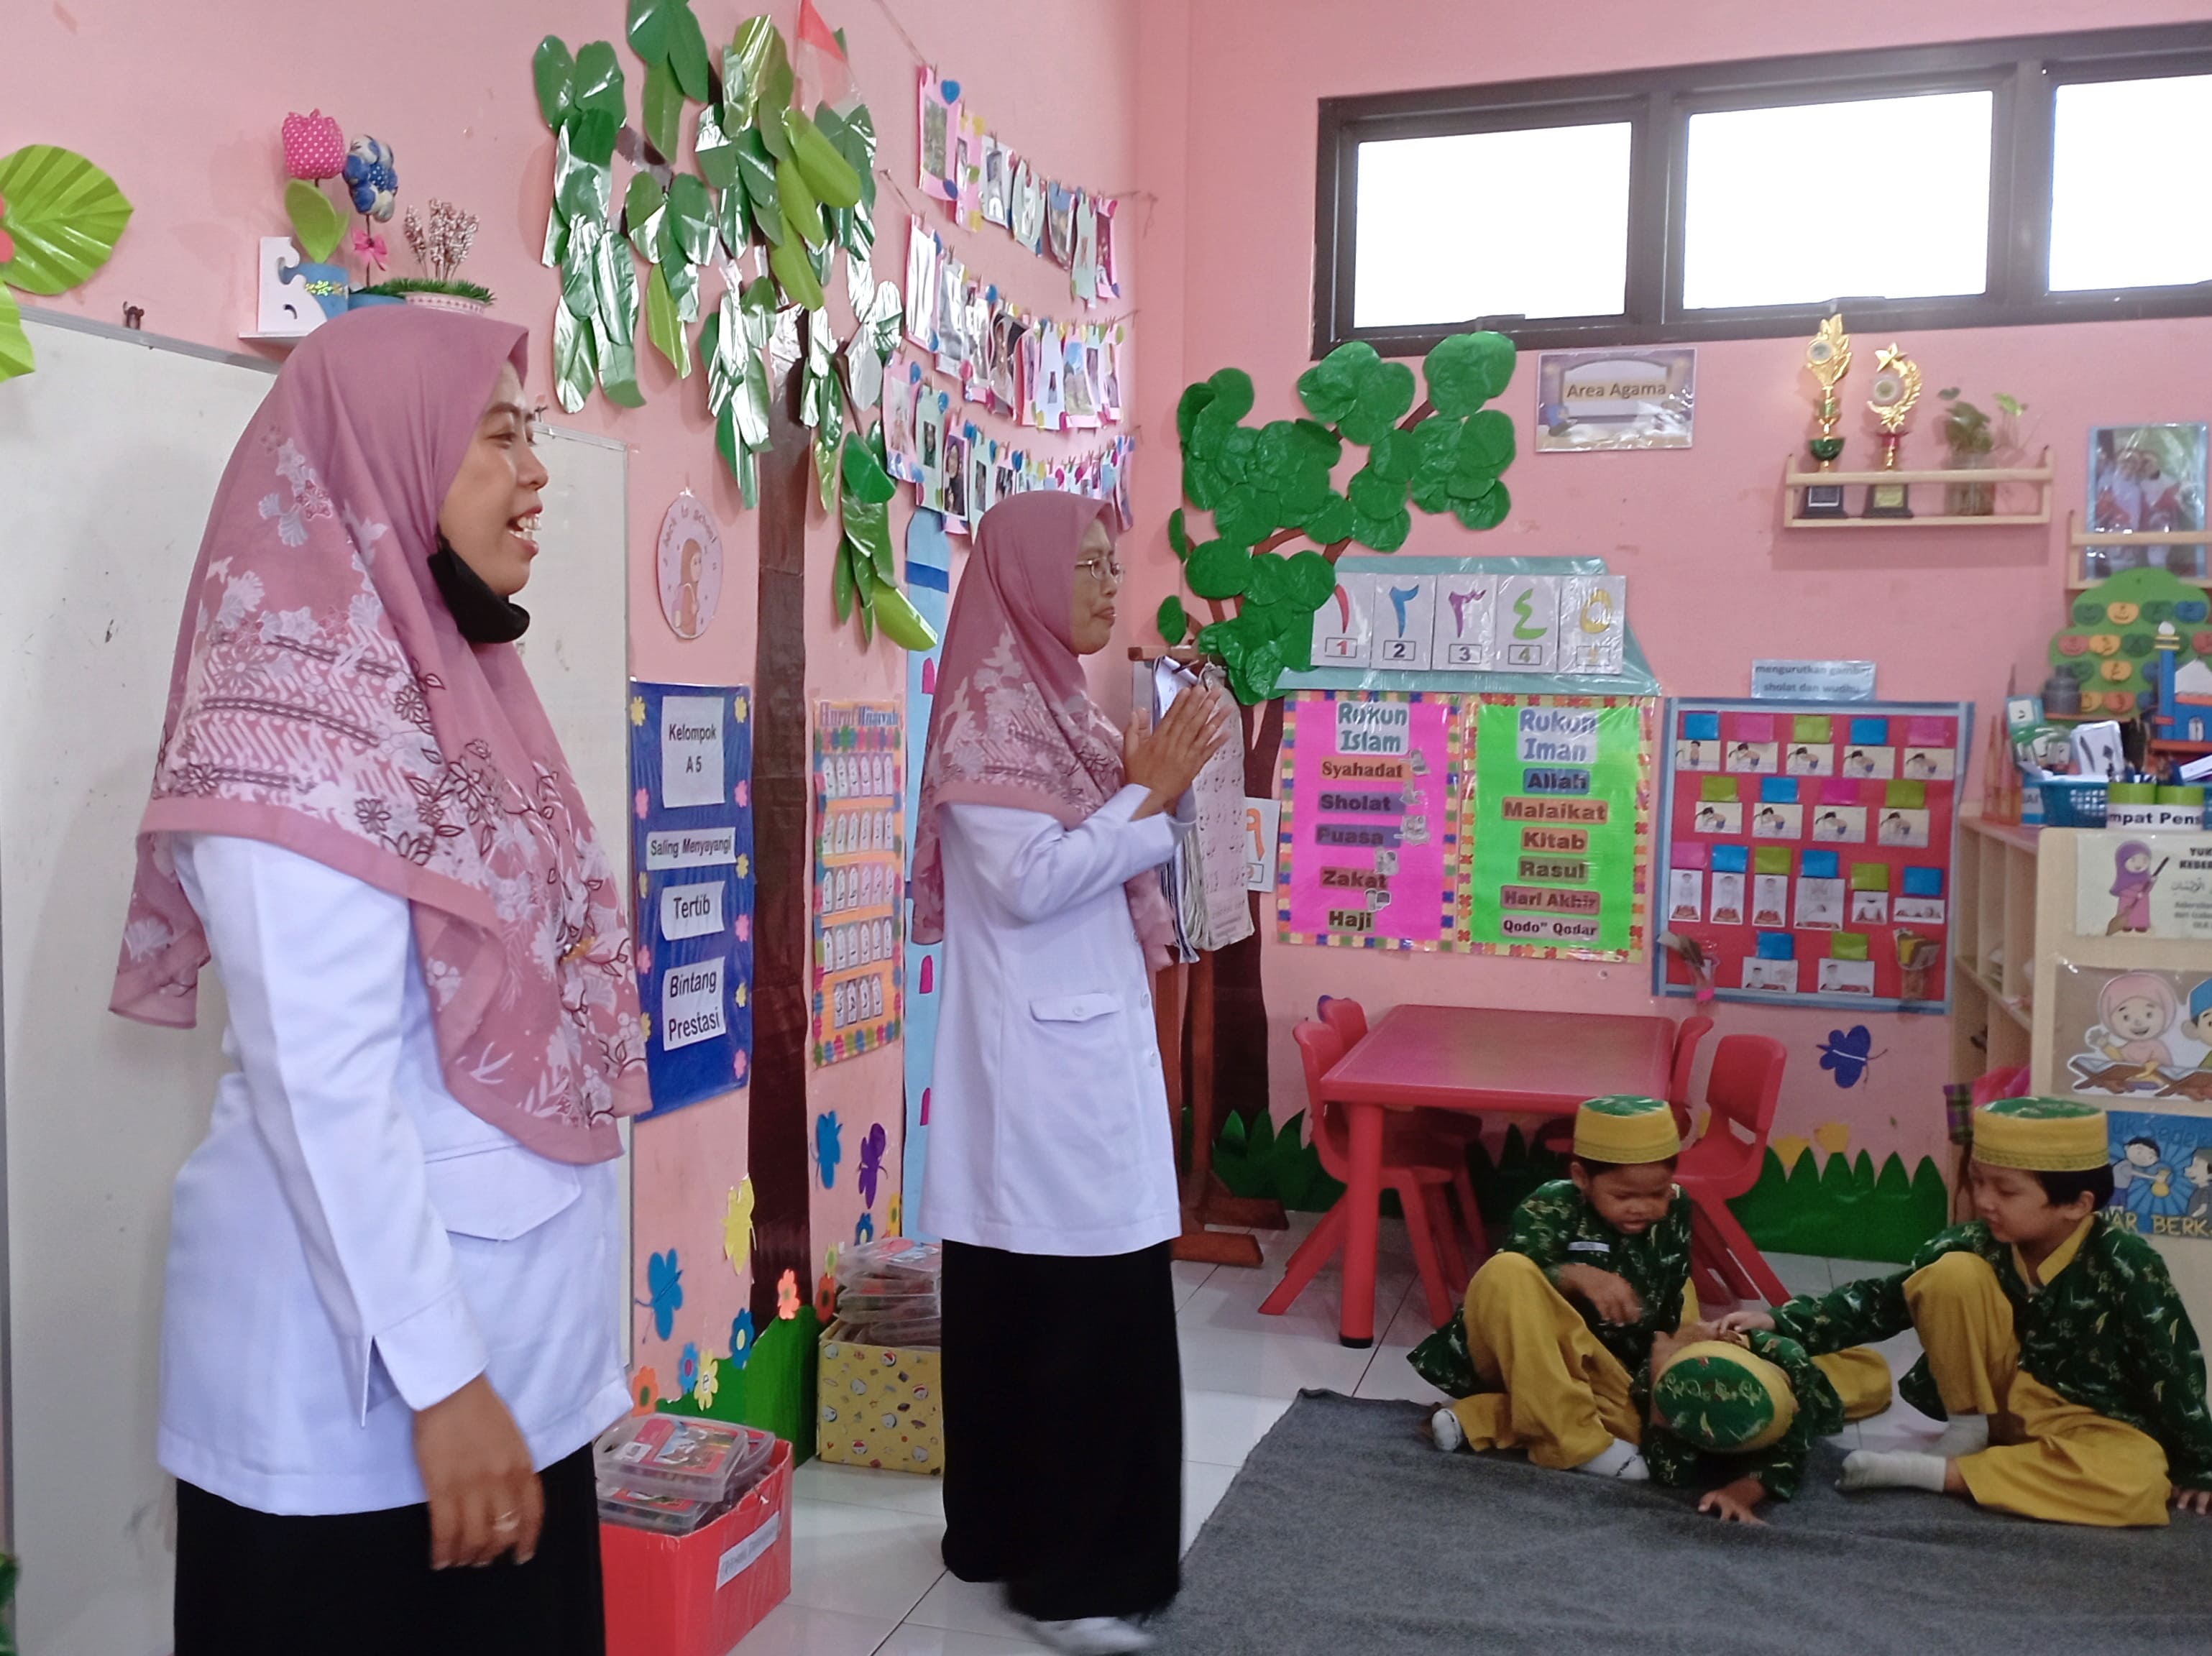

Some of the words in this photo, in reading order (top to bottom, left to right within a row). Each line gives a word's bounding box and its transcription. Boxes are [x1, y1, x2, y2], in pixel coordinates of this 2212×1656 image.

[1567, 383, 1605, 397] Area
[1610, 382, 1666, 399] Agama
[1336, 640, 1347, 656] 1
[1393, 643, 1405, 658] 2
[1459, 647, 1471, 661] 3
[1518, 647, 1530, 663] 4
[1756, 665, 1827, 675] mengurutkan
[1763, 682, 1796, 691] sholat
[1799, 683, 1819, 691] dan
[1339, 703, 1408, 726] Rukun
[1520, 709, 1596, 733] Rukun
[669, 724, 716, 743] Kelompok
[1340, 730, 1400, 752] Islam
[1523, 738, 1586, 761] Iman
[686, 755, 694, 773] A
[696, 756, 702, 773] 5
[1322, 762, 1403, 779] Syahadat
[1527, 773, 1587, 789] Allah
[1321, 794, 1391, 811] Sholat
[1504, 801, 1605, 820] Malaikat
[1316, 827, 1383, 845] Puasa
[1523, 832, 1585, 850] Kitab
[651, 840, 679, 858] Saling
[682, 835, 731, 856] Menyayangi
[1520, 860, 1584, 878] Rasul
[1322, 870, 1387, 888] Zakat
[674, 893, 710, 919] Tertib
[1504, 891, 1542, 906] Hari
[1547, 893, 1597, 908] Akhir
[1328, 911, 1372, 931] Haji
[1553, 923, 1597, 936] Qodar
[670, 971, 717, 998] Bintang
[669, 1006, 720, 1041] Prestasi
[2152, 1215, 2212, 1236] BERK
